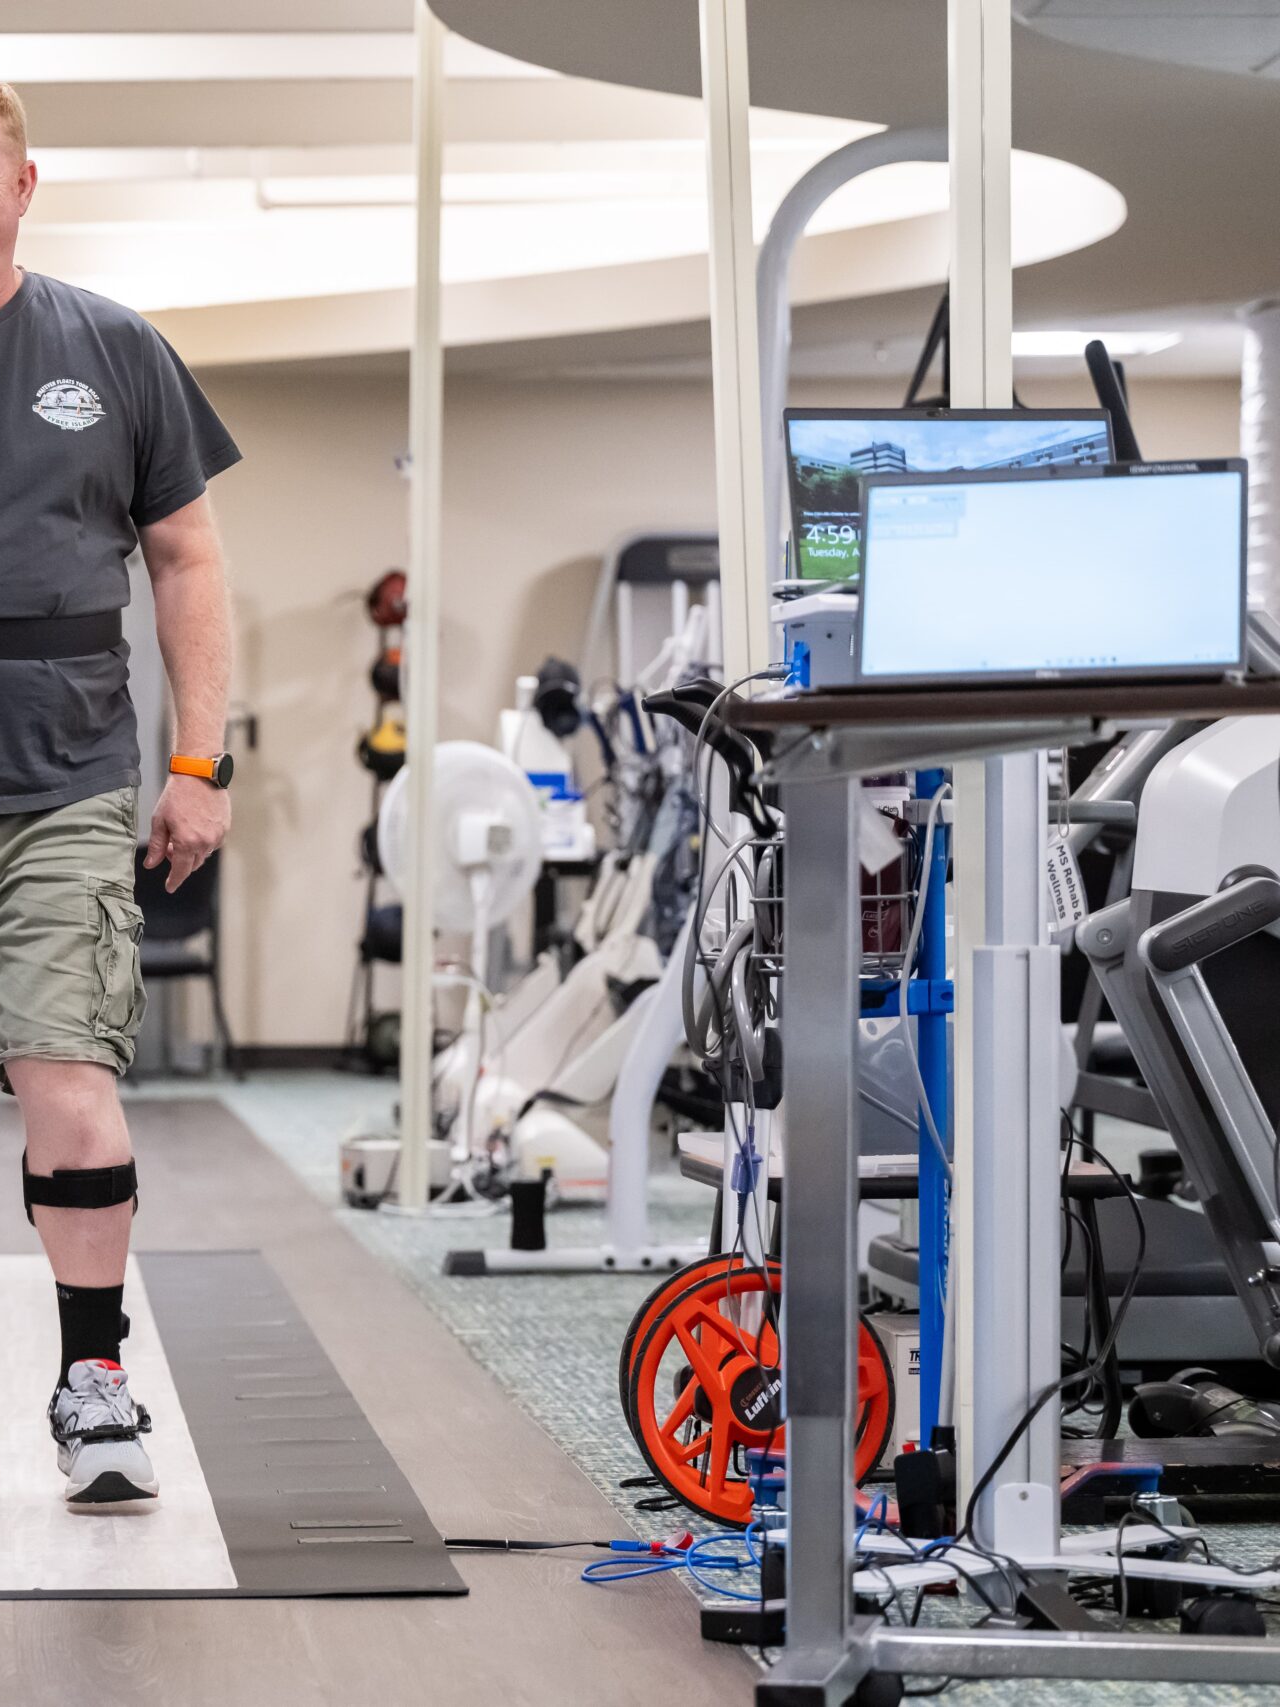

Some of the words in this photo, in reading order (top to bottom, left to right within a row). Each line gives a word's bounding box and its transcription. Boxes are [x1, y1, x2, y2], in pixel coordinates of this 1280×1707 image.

[72, 417, 95, 427] ISLAND
[806, 525, 853, 545] 4:59
[808, 547, 849, 559] Tuesday,
[1047, 859, 1066, 920] Wellness
[1056, 844, 1069, 866] MS
[1063, 867, 1080, 909] Rehab
[1073, 911, 1082, 921] &
